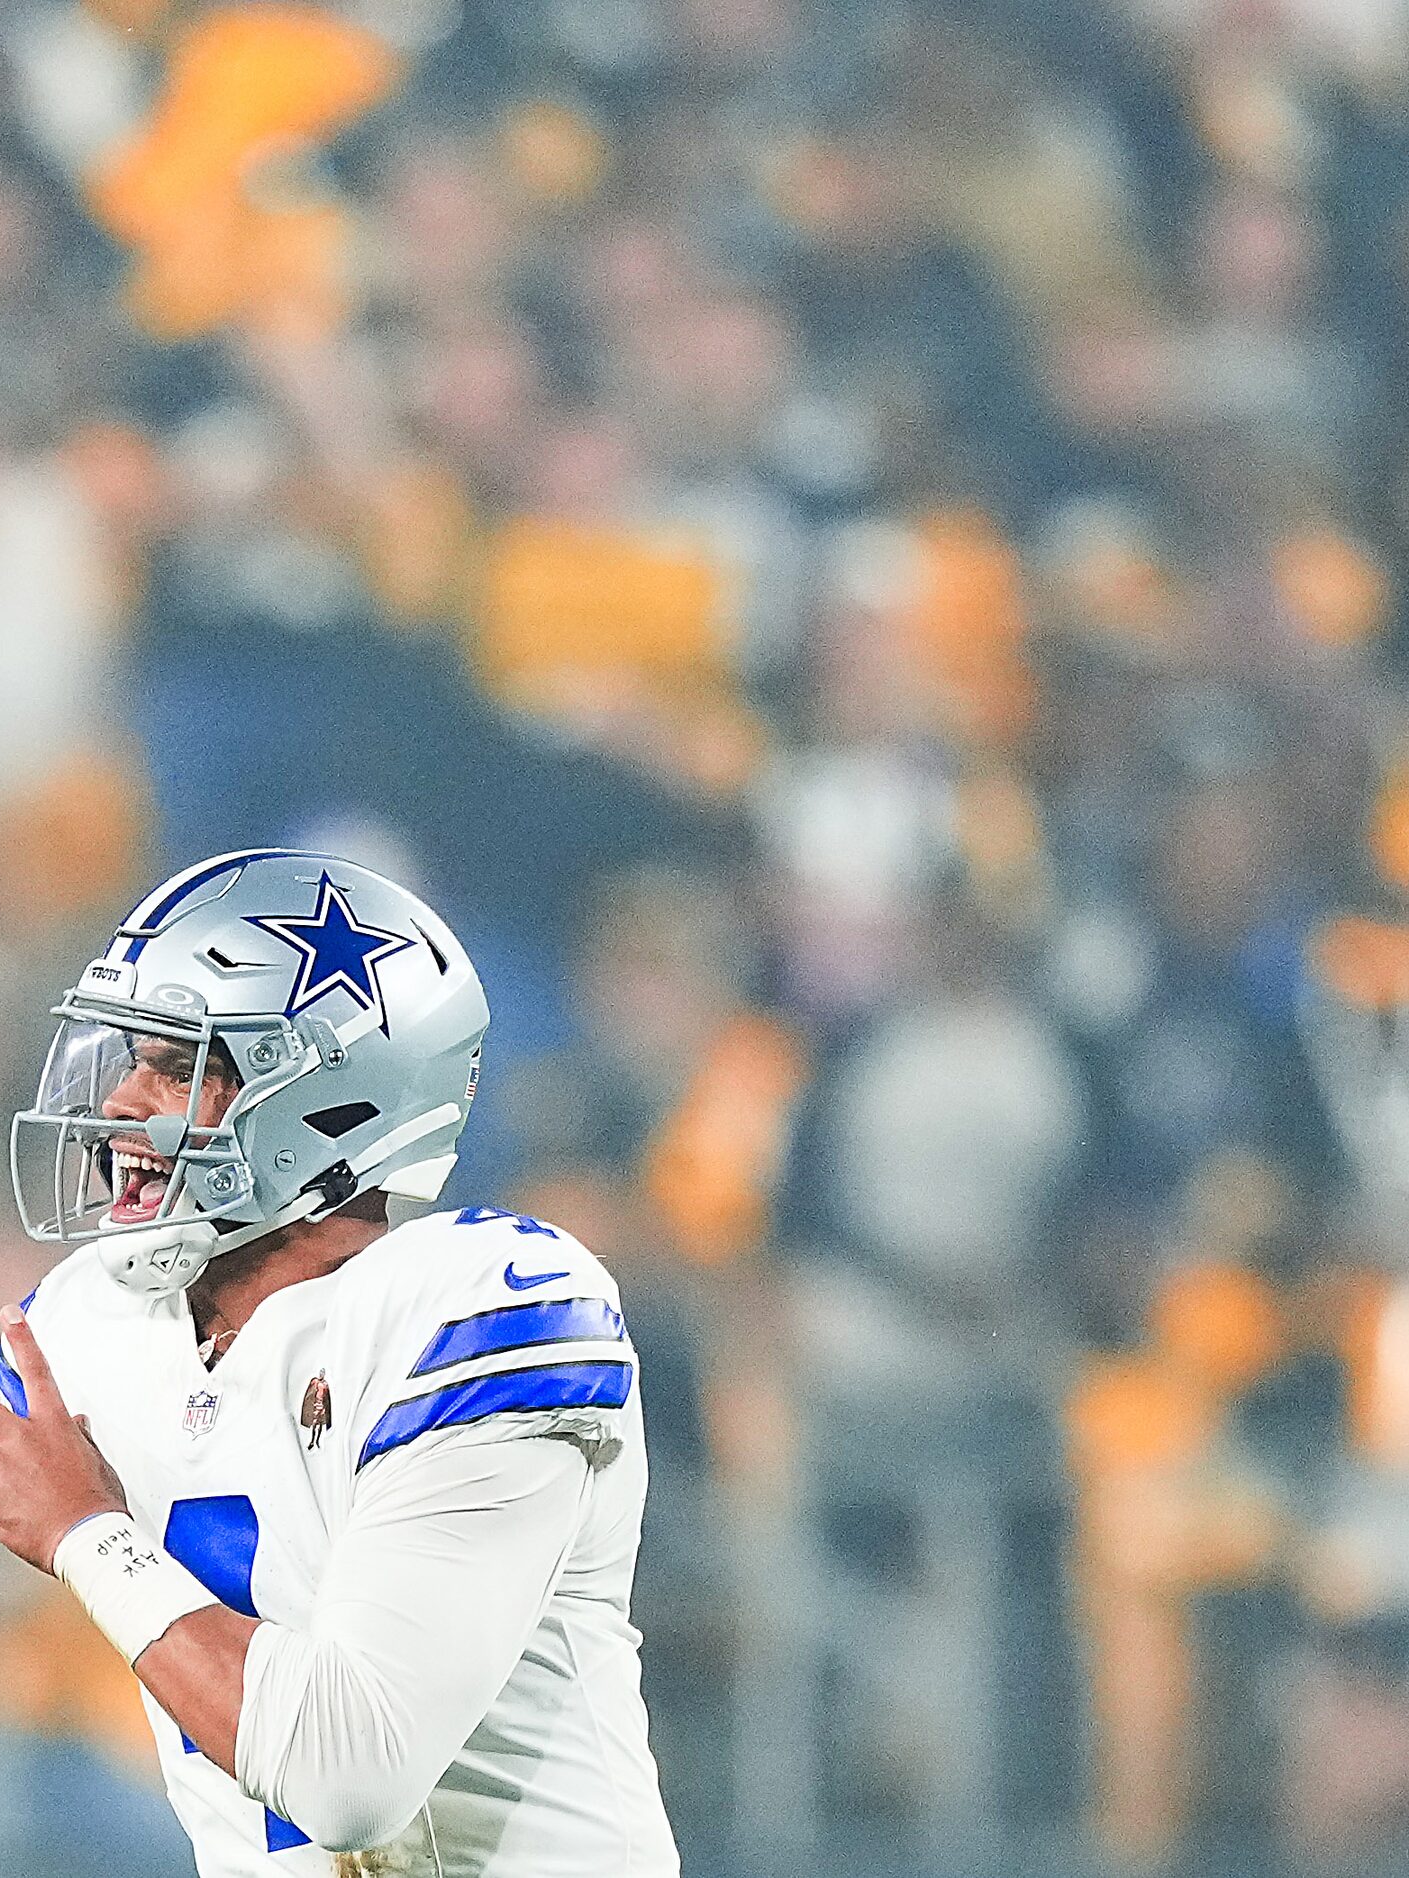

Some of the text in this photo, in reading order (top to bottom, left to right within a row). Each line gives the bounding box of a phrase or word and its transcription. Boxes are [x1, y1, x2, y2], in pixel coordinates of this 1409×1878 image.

[185, 1409, 208, 1428] NFL
[121, 1545, 134, 1557] 4
[123, 1549, 160, 1578] ASK
